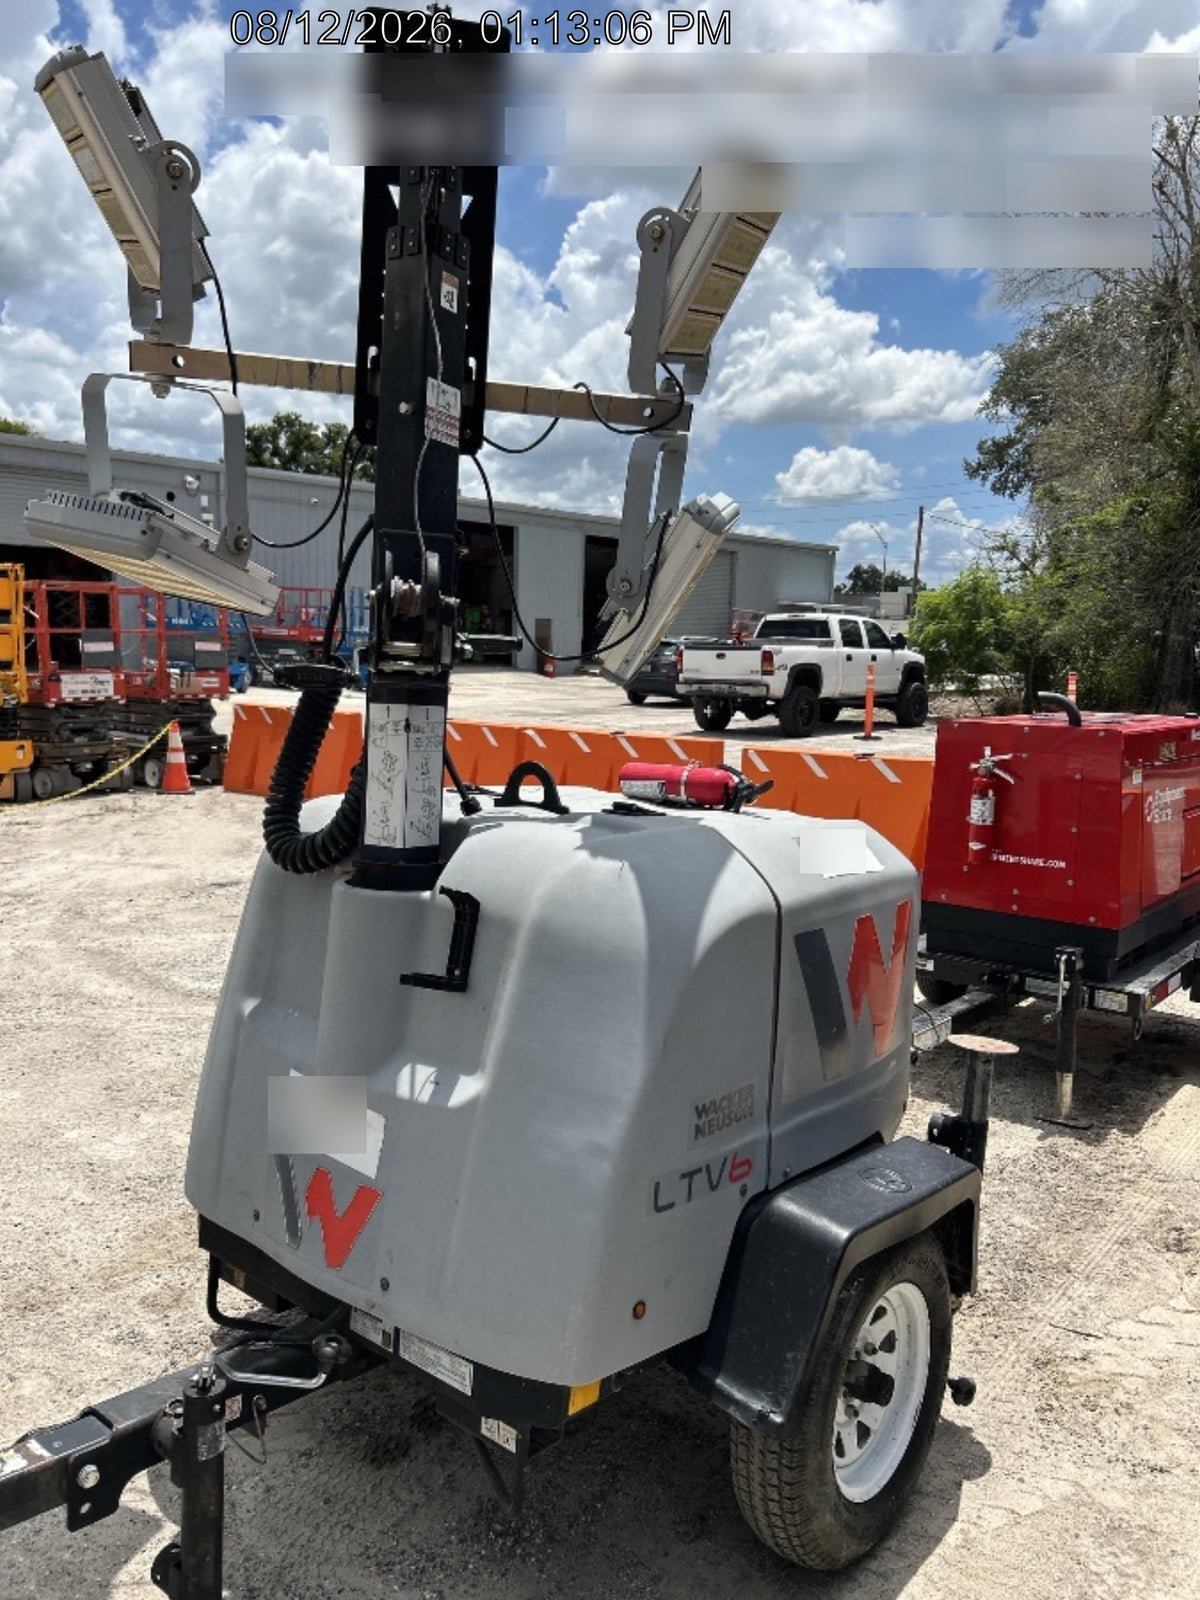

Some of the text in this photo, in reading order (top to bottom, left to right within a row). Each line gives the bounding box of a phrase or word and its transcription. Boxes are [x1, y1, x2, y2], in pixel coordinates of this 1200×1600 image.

[990, 852, 1067, 869] PMENTSHARE.COM
[694, 1083, 755, 1121] WACKER
[694, 1106, 755, 1140] NEUSON
[653, 1151, 753, 1213] LTV6
